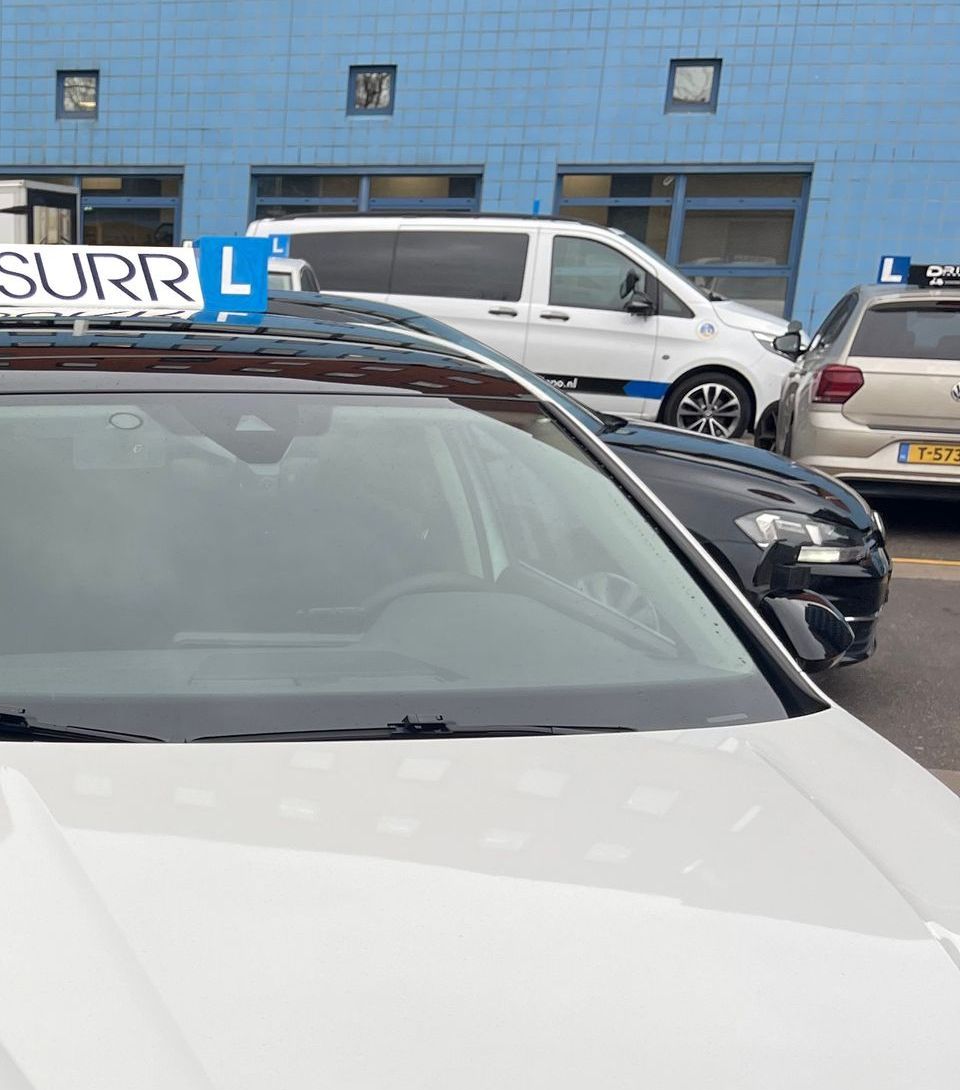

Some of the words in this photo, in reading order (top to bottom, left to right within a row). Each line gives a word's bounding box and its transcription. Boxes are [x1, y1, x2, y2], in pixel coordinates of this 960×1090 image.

[272, 237, 284, 253] L
[221, 246, 251, 295] L
[881, 257, 903, 283] L
